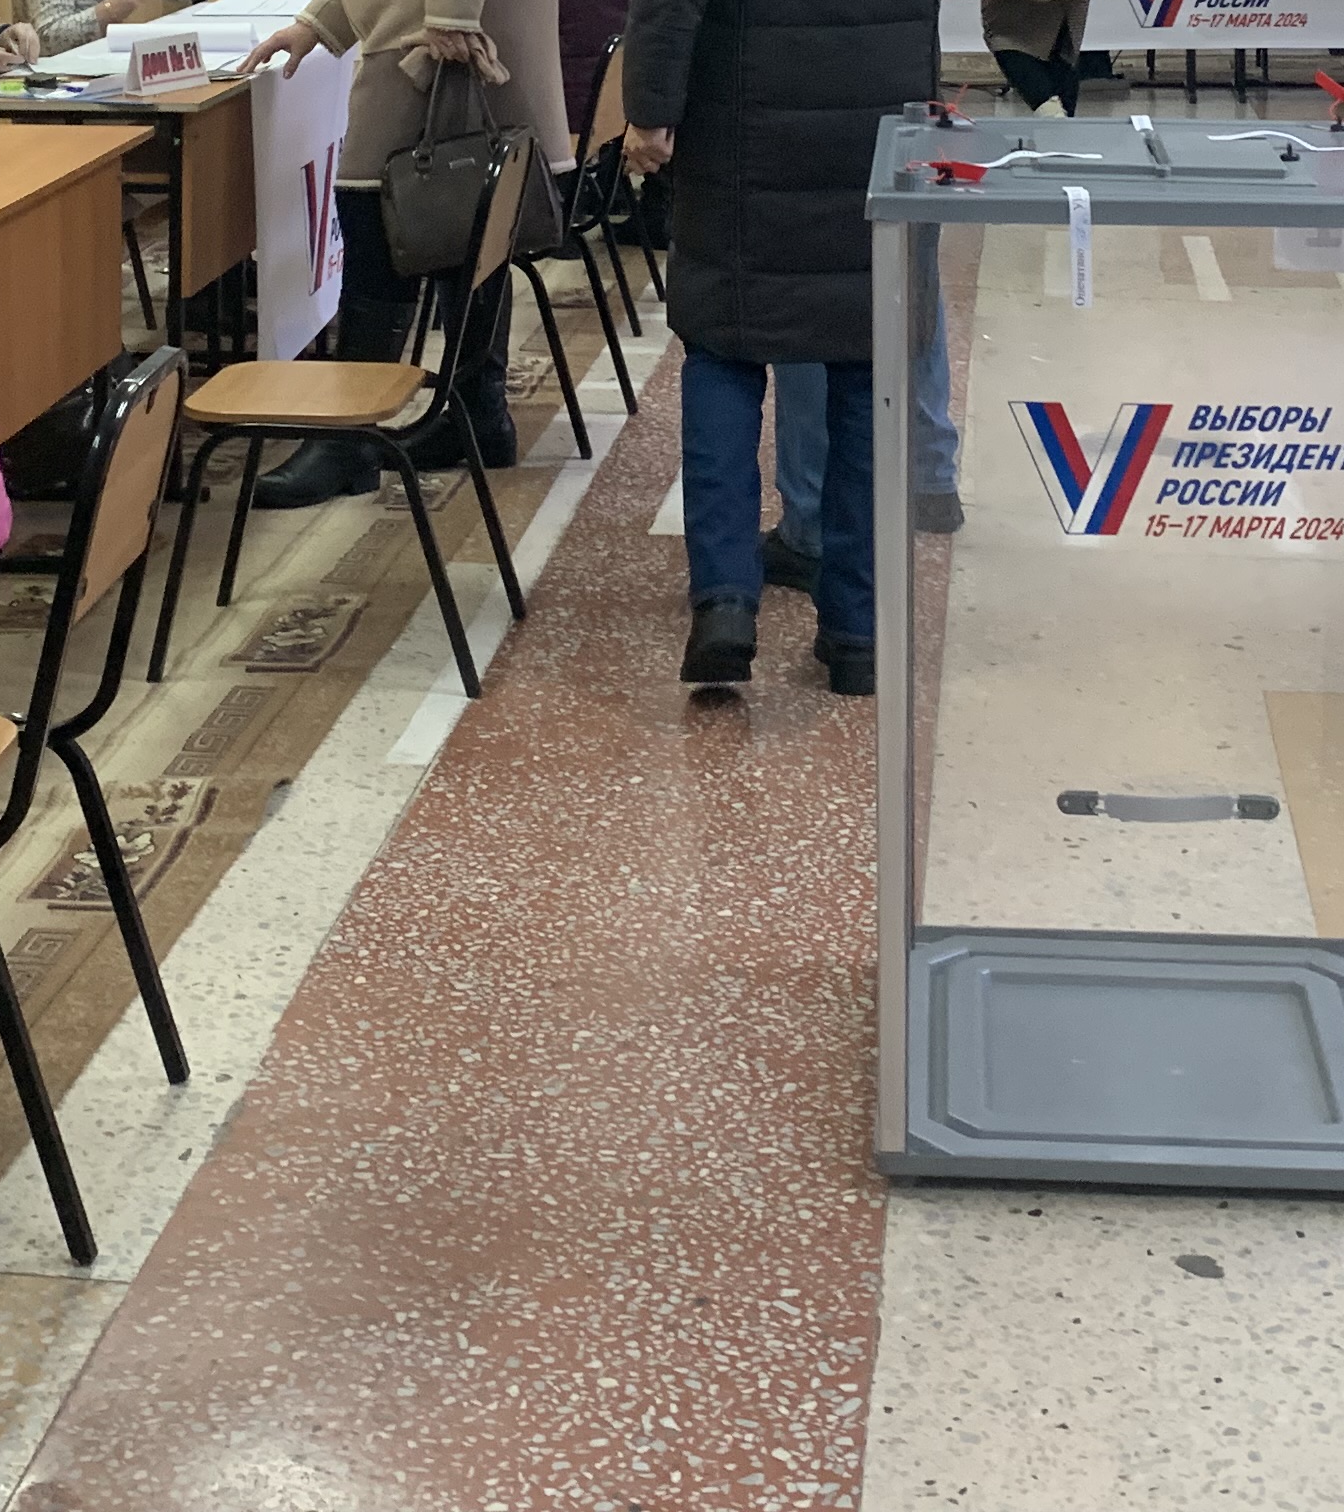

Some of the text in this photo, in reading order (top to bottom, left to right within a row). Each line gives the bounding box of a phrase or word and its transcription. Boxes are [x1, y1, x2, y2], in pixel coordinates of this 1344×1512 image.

[1227, 13, 1271, 28] МАРТА
[1273, 13, 1308, 27] 2024
[183, 42, 201, 70] 51
[1187, 404, 1332, 433] ВЫБОРЫ
[1155, 478, 1286, 507] РОССИИ
[1208, 516, 1287, 539] МАРТА
[1289, 517, 1344, 540] 2024
